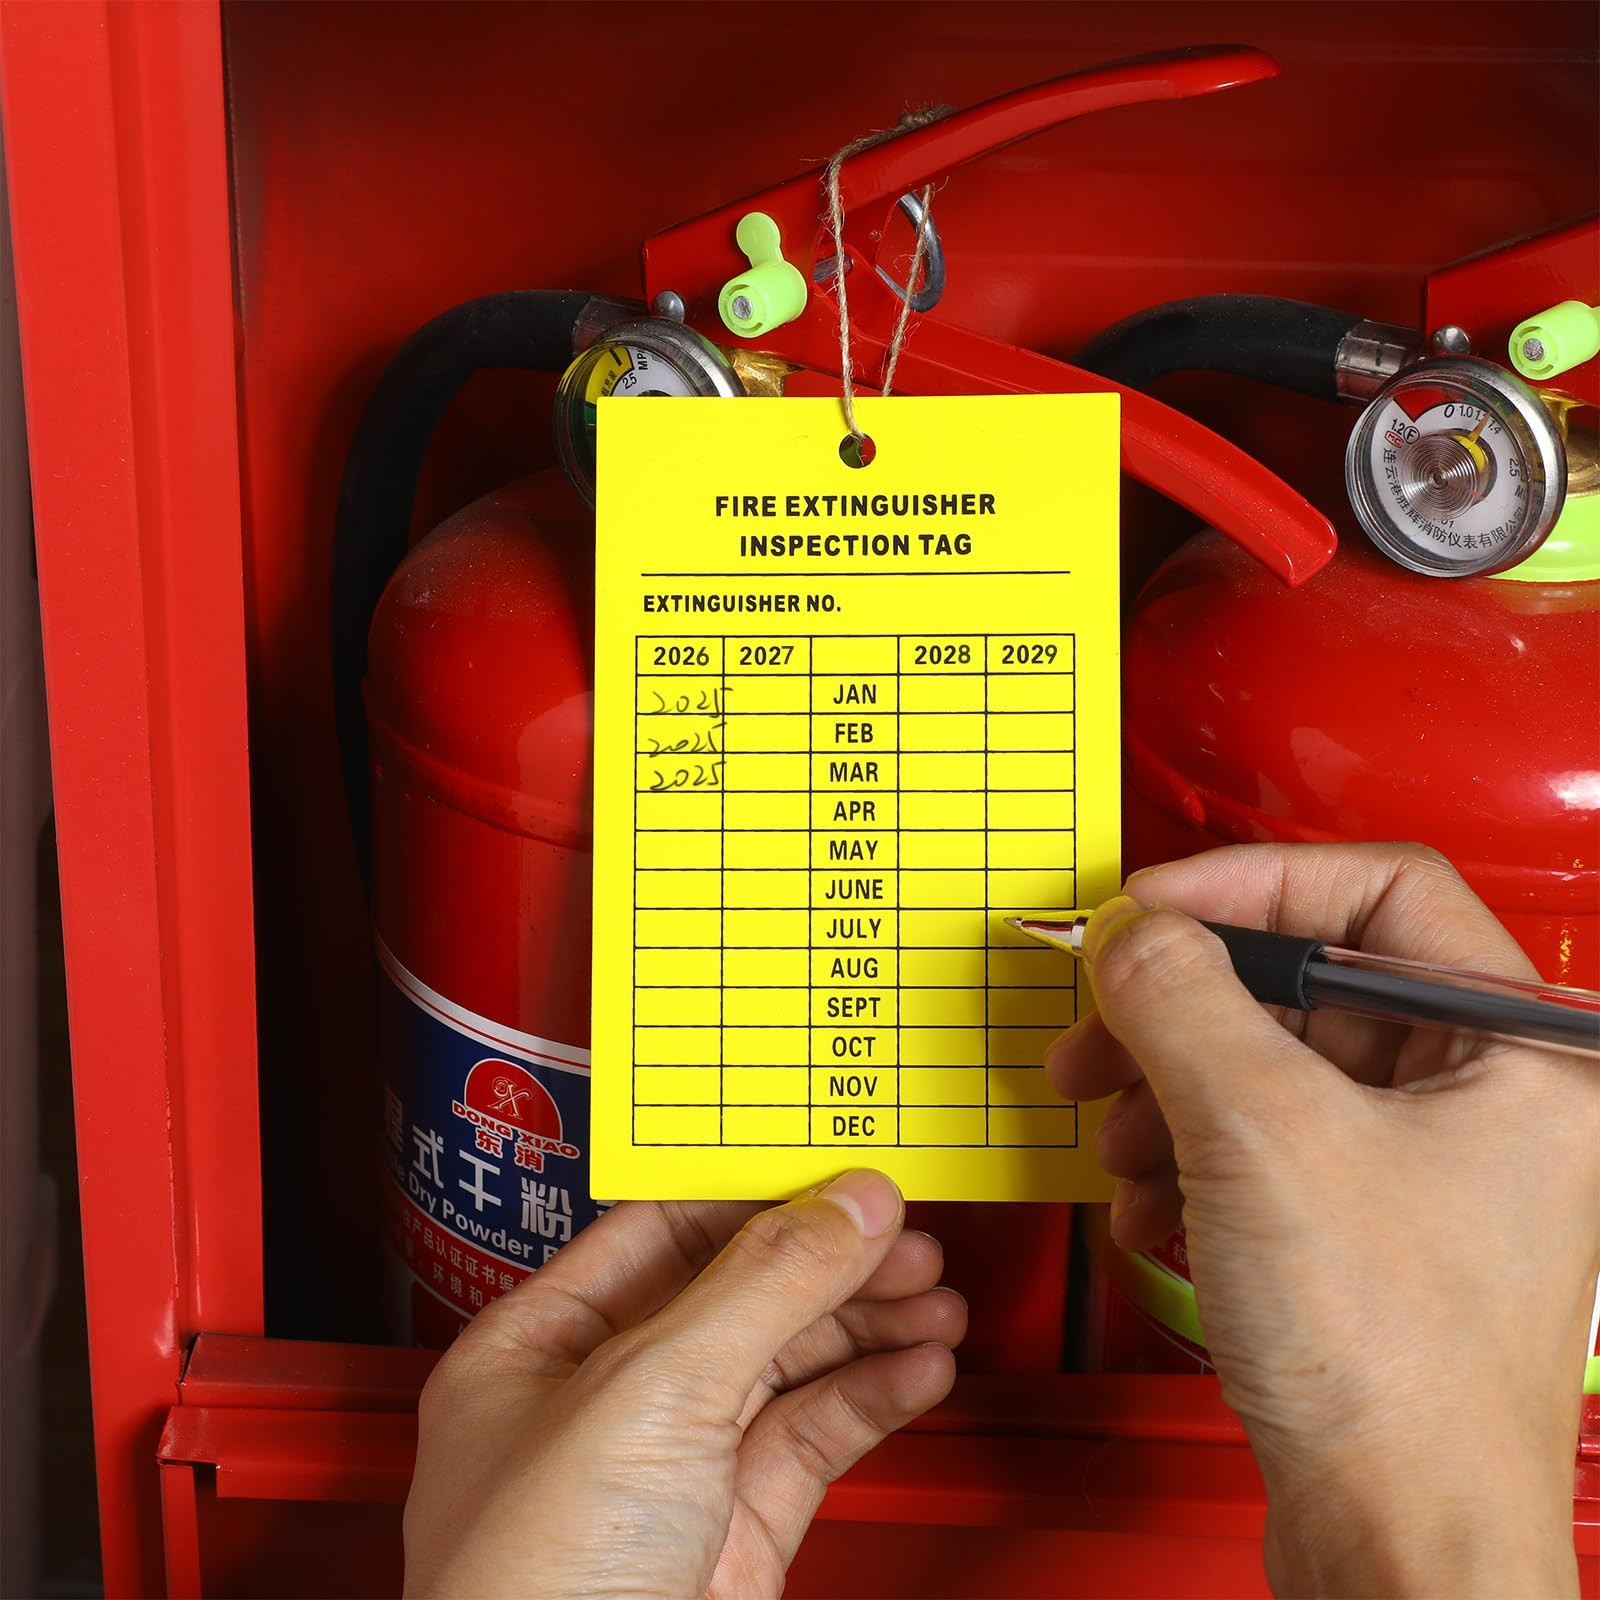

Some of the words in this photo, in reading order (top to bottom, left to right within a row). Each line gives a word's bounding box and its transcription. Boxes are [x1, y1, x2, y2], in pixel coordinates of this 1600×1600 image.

[1390, 418, 1404, 435] 1.2
[1443, 404, 1455, 418] 0
[1459, 404, 1474, 418] 1.0
[1487, 419, 1503, 435] 1.4
[1509, 458, 1521, 477] 2.5
[715, 493, 777, 517] FIRE
[785, 493, 996, 517] EXTINGUISHER
[740, 534, 910, 558] INSPECTION
[918, 533, 972, 557] TAG
[643, 594, 801, 613] EXTINGUISHER
[806, 594, 841, 612] NO.
[653, 645, 710, 667] 2026
[739, 645, 795, 666] 2027
[914, 644, 971, 665] 2028
[1001, 644, 1058, 665] 2029
[651, 688, 733, 718] 2025
[832, 683, 877, 705] JAN
[835, 722, 874, 744] FEB
[650, 761, 727, 791] 2025
[829, 761, 879, 783] MAR
[833, 800, 876, 822] APR
[829, 839, 879, 861] MAY
[825, 878, 884, 900] JUNE
[826, 918, 882, 939] JULY
[830, 957, 879, 979] AUG
[826, 996, 881, 1018] SEPT
[831, 1036, 877, 1058] OCT
[829, 1075, 878, 1097] NOV
[452, 1100, 513, 1140] DONG
[517, 1132, 580, 1159] XIAO
[832, 1115, 875, 1137] DEC
[408, 1173, 437, 1215] Dry
[442, 1197, 534, 1260] Powder
